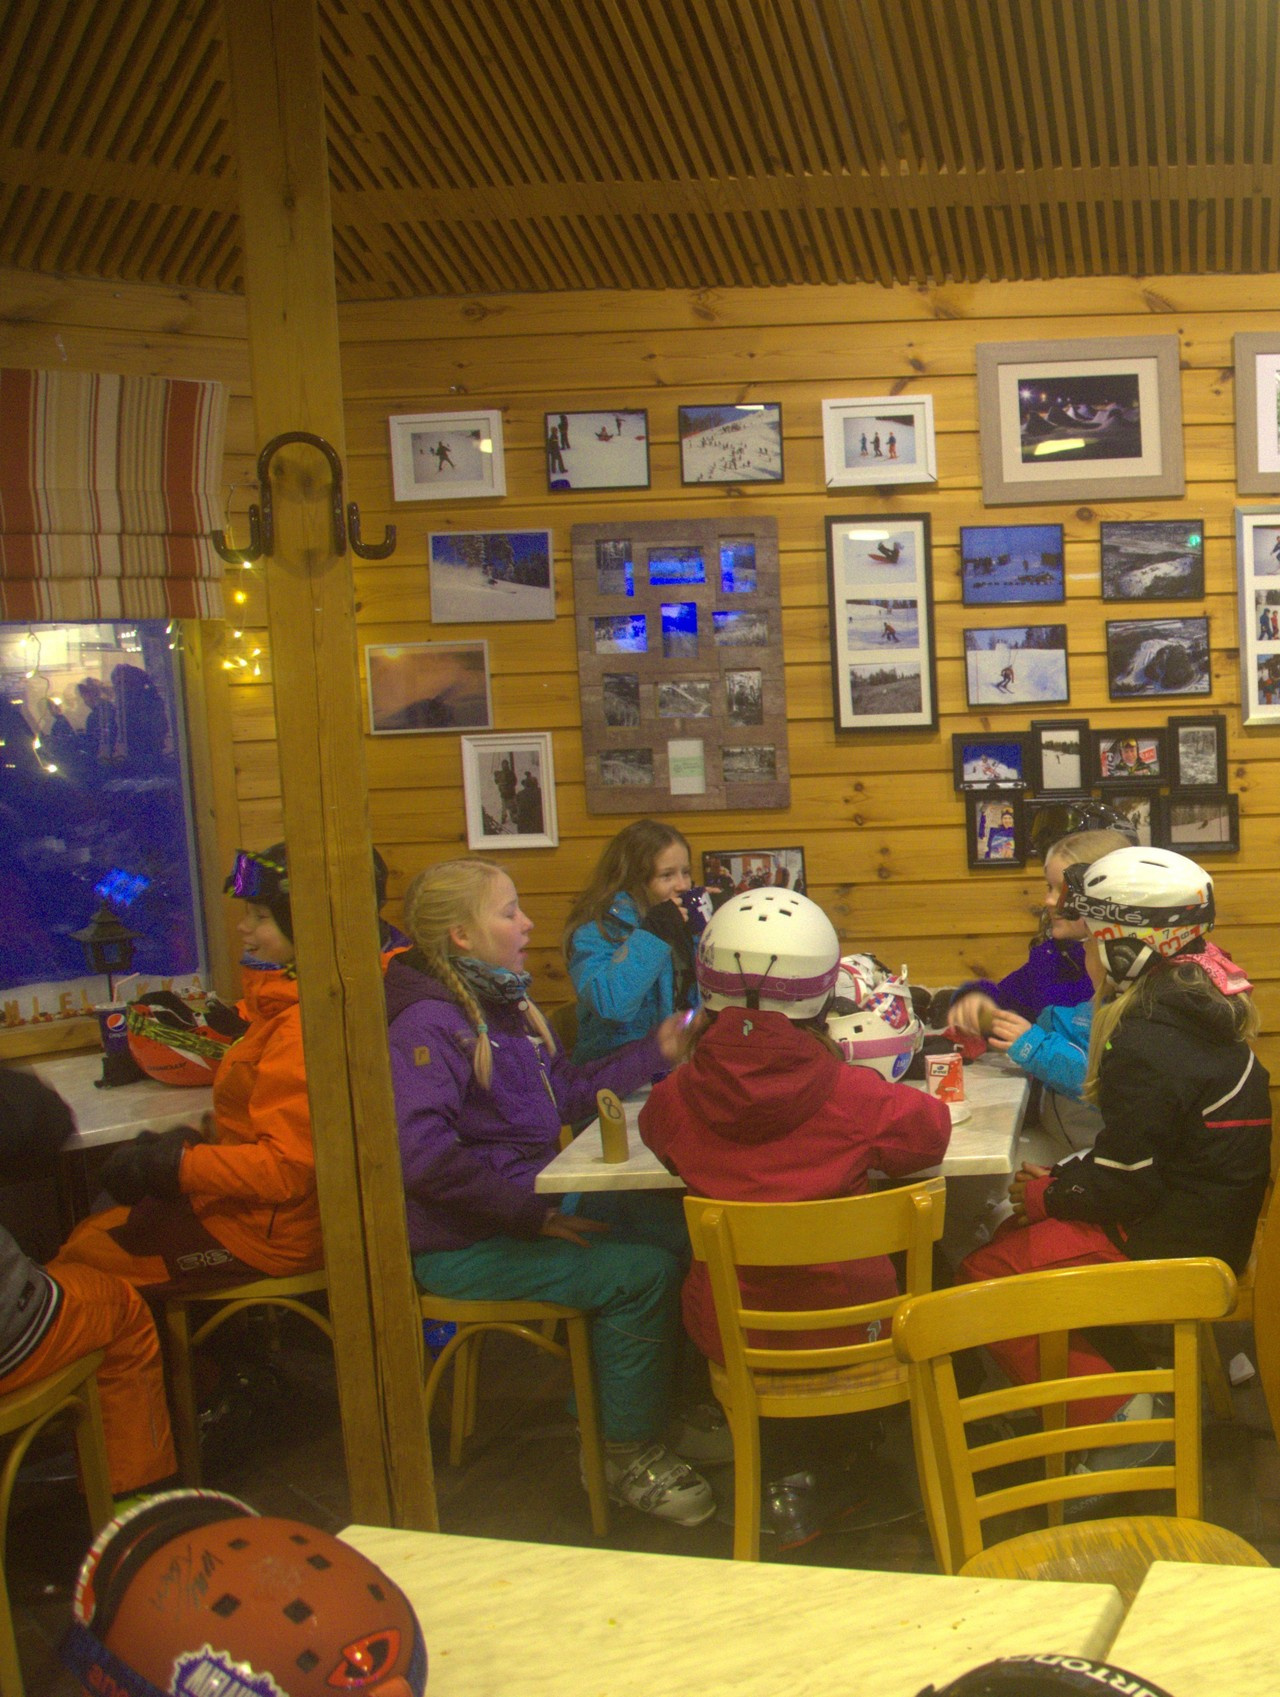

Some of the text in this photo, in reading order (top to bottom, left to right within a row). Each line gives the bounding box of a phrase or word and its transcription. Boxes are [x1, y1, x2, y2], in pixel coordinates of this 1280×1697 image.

[1073, 893, 1143, 924] bollé
[602, 1096, 622, 1120] 8
[1034, 1654, 1161, 1697] URTON
